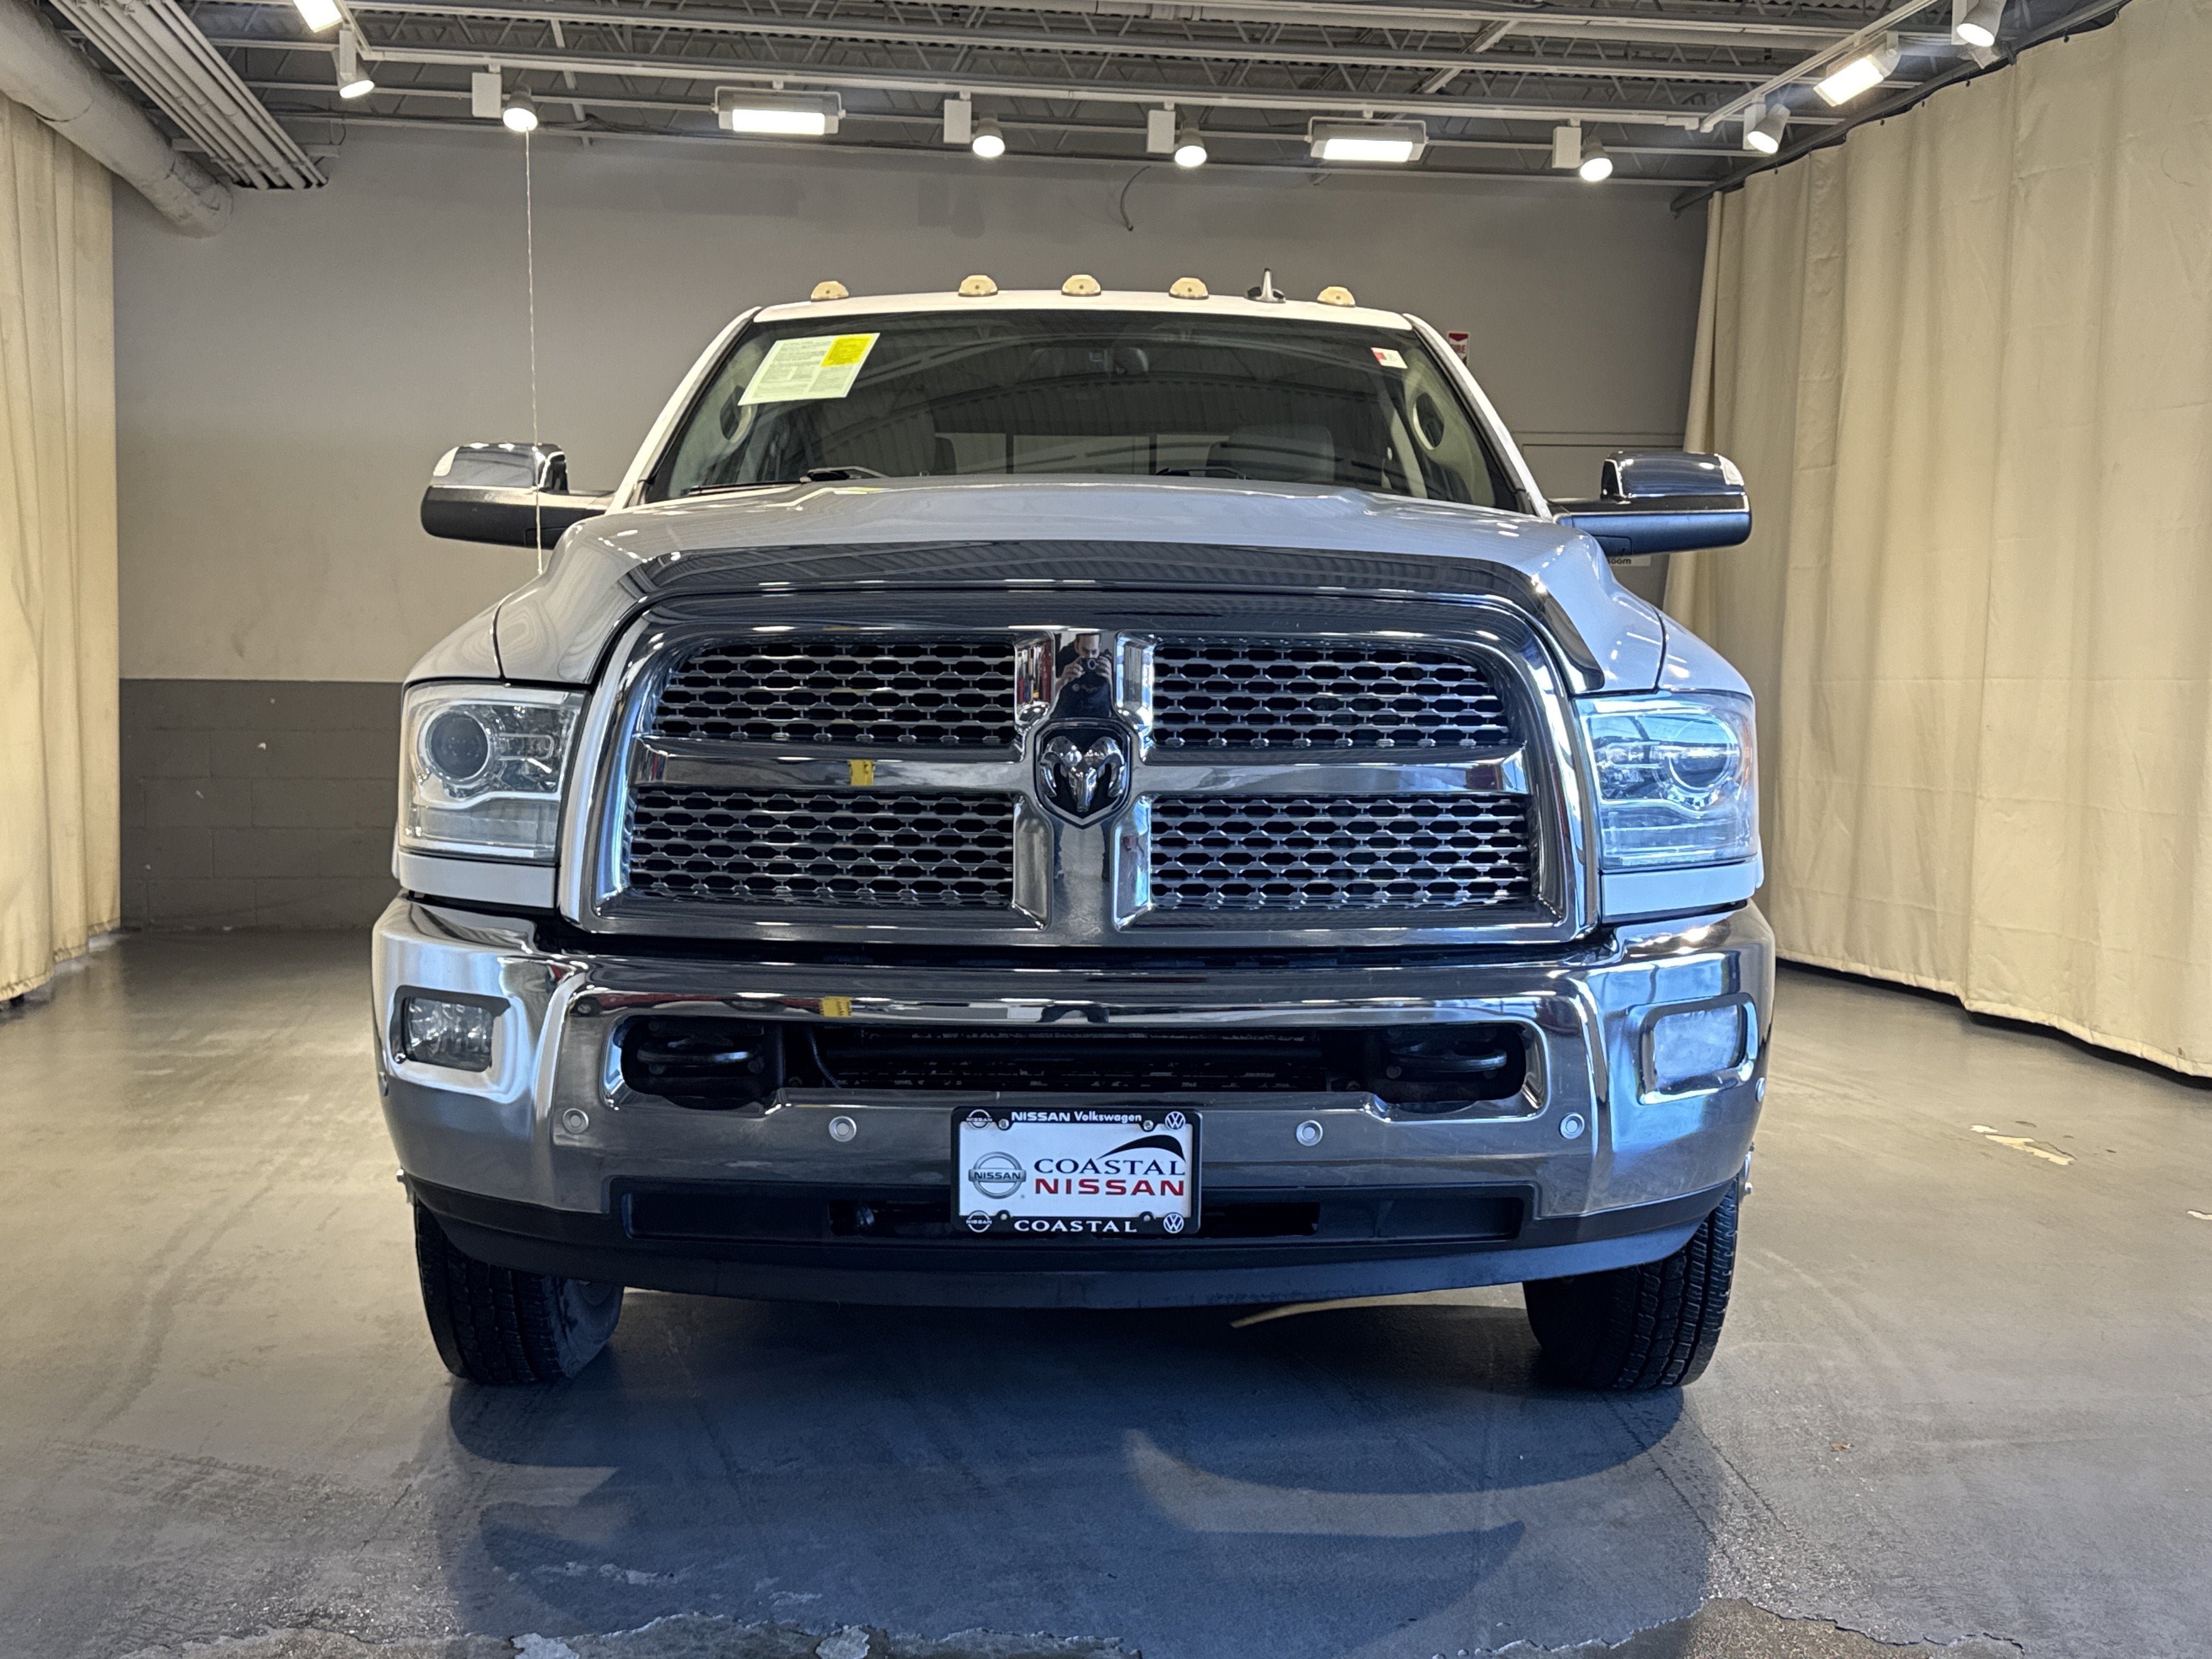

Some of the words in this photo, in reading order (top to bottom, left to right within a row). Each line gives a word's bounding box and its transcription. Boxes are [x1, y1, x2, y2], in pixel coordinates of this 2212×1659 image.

[1012, 1111, 1070, 1122] NISSAN
[1075, 1111, 1142, 1122] Volkswagen
[1034, 1158, 1186, 1175] COASTAL
[1035, 1178, 1184, 1195] NISSAN
[1014, 1220, 1137, 1233] COASTAL
